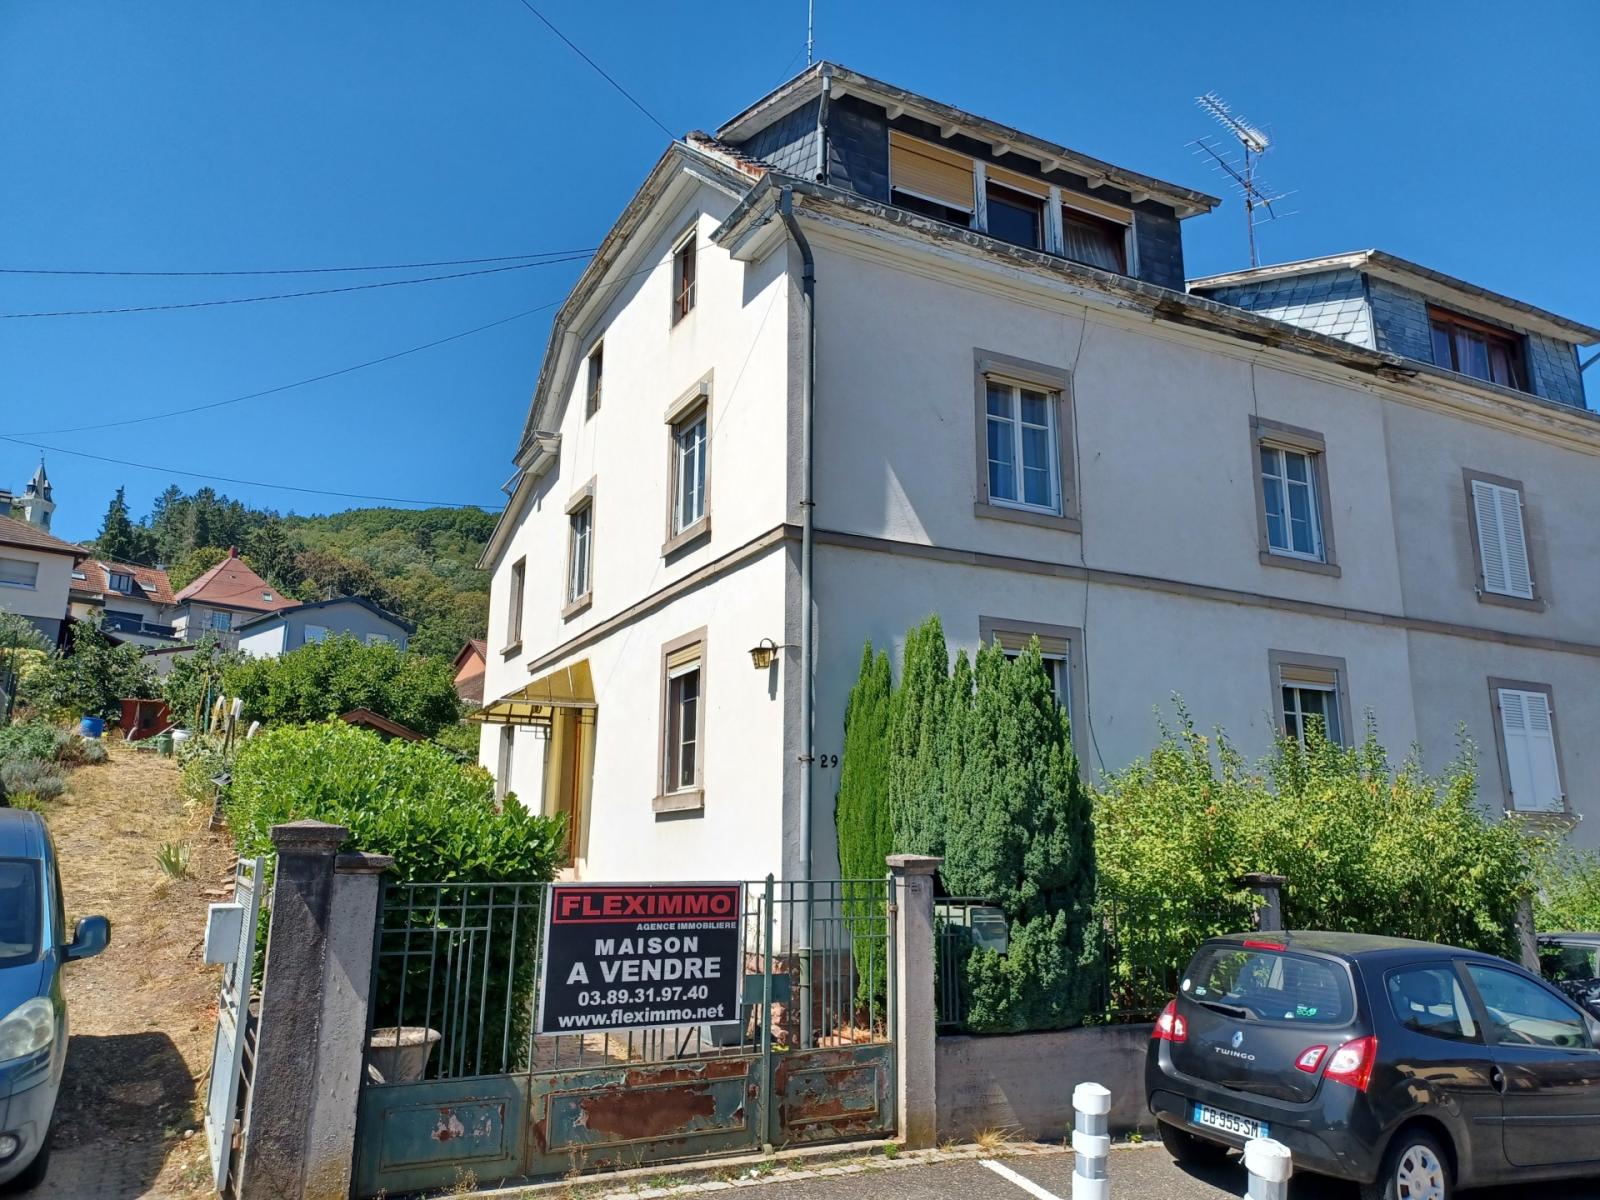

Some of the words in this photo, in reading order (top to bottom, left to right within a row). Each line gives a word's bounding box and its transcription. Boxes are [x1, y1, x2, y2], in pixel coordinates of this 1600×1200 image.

[820, 754, 838, 768] 29
[561, 895, 731, 916] FLEXIMMO
[636, 922, 676, 931] AGENCE
[677, 921, 737, 930] IMMOBILIERE
[594, 936, 699, 955] MAISON
[566, 962, 590, 984] A
[599, 957, 721, 983] VENDRE
[578, 985, 708, 1006] 03.89.31.97.40
[558, 1003, 724, 1028] www.fleximmo.net
[1214, 1046, 1255, 1061] TWINGO
